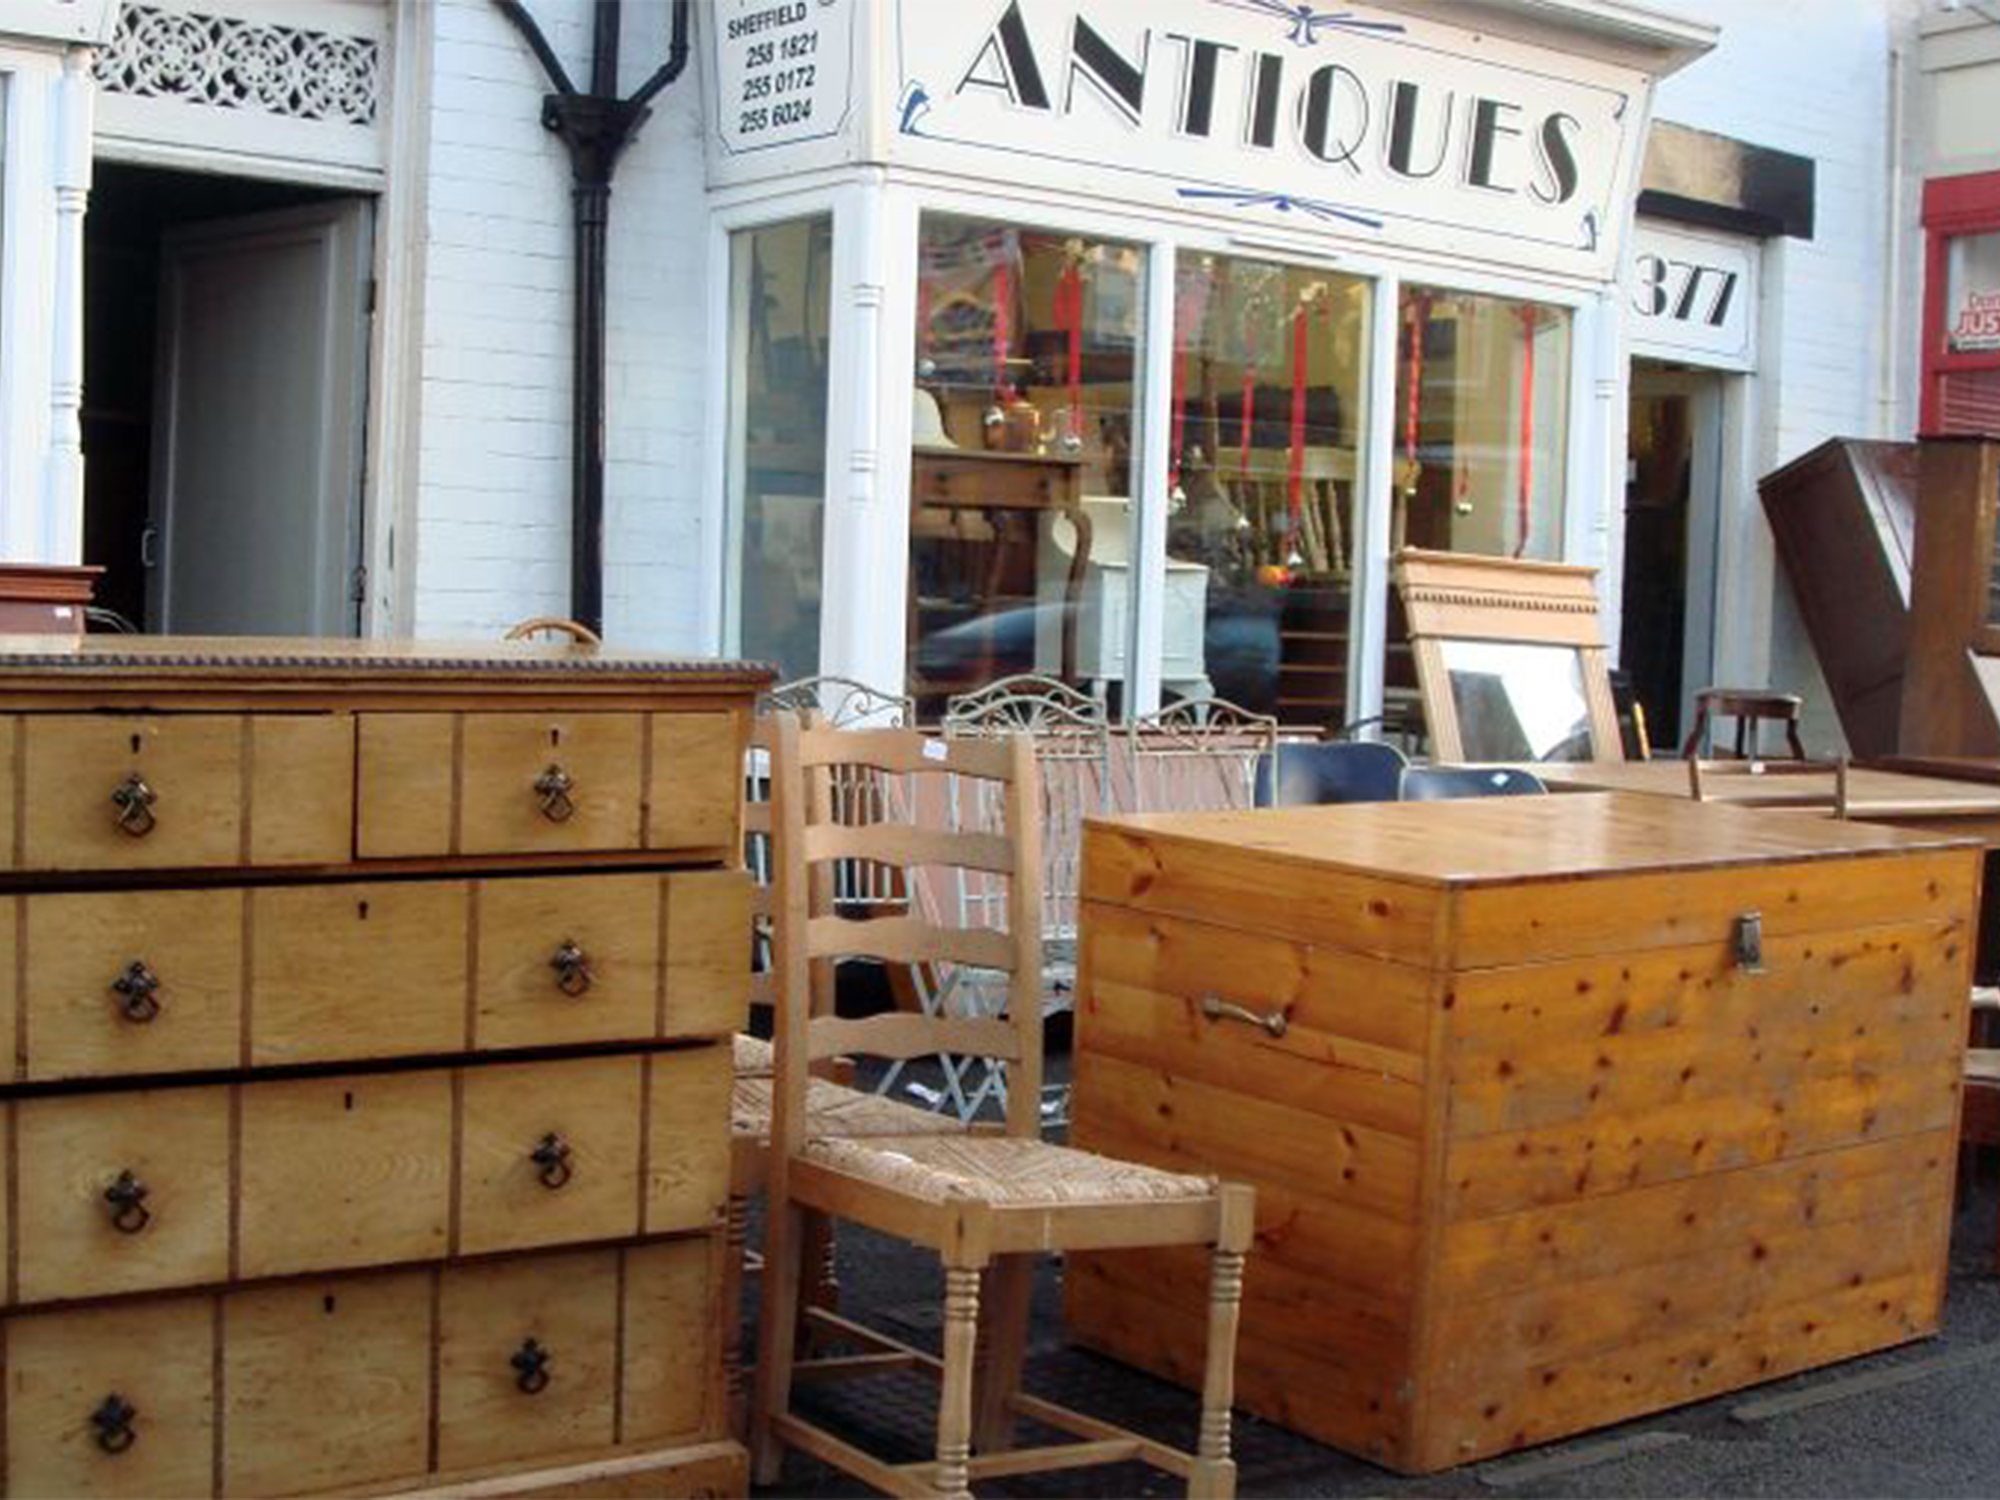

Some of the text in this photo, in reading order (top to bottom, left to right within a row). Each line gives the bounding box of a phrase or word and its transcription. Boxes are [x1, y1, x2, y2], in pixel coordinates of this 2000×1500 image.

[728, 2, 807, 39] SHEFFIELD
[743, 64, 814, 101] 255 0172
[739, 98, 811, 134] 255 6024
[955, 0, 1581, 204] ANTIQUES
[1632, 253, 1737, 326] 377
